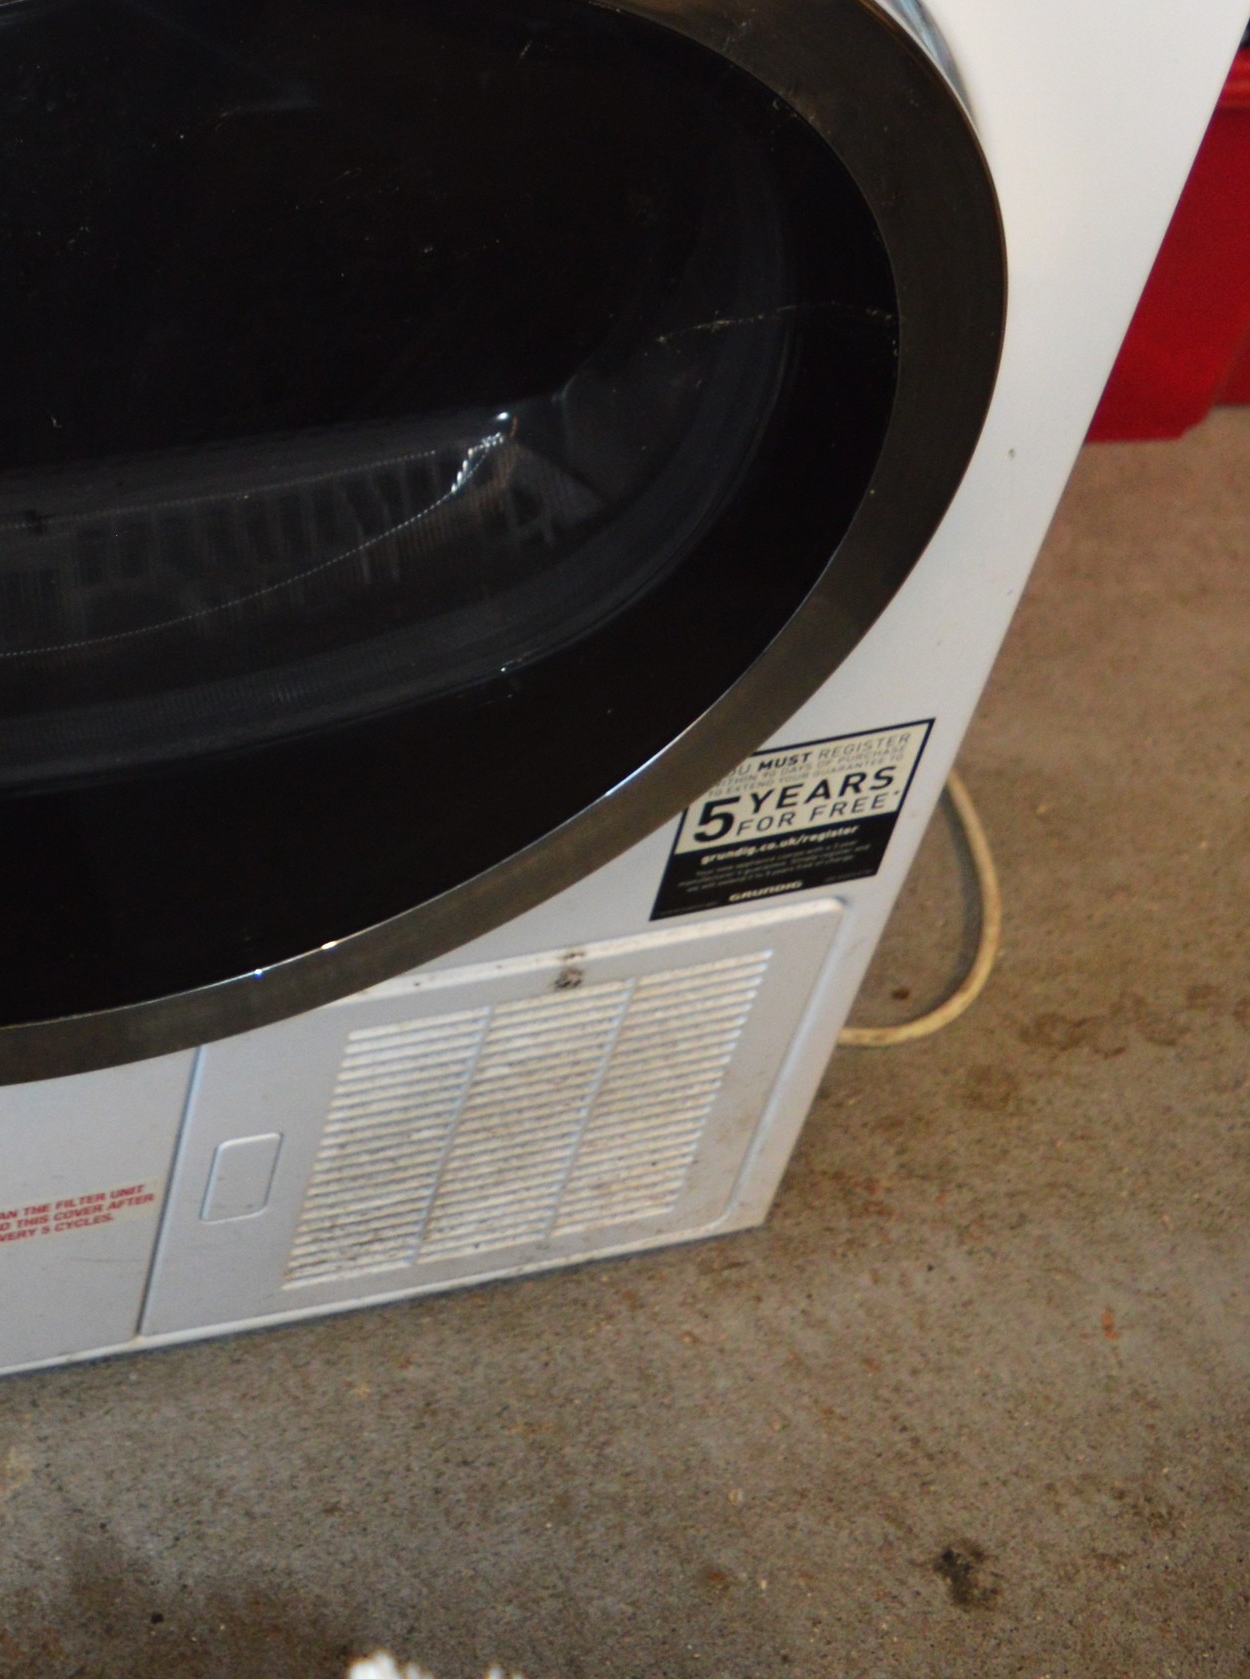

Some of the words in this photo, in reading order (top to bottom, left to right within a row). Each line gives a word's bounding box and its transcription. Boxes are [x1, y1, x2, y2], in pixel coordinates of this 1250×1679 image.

[758, 751, 814, 772] MUST
[817, 733, 912, 760] REGISTER
[693, 796, 741, 844] 5
[751, 766, 898, 814] YEARS
[736, 812, 796, 836] FOR
[700, 825, 860, 866] grundig.co.uk/register
[728, 880, 803, 903] GRUNDIG
[16, 1214, 49, 1229] THIS
[52, 1205, 103, 1222] COVER
[106, 1192, 155, 1211] AFTER
[23, 1202, 51, 1216] THE
[55, 1192, 106, 1210] FILTER
[109, 1184, 146, 1199] UNIT
